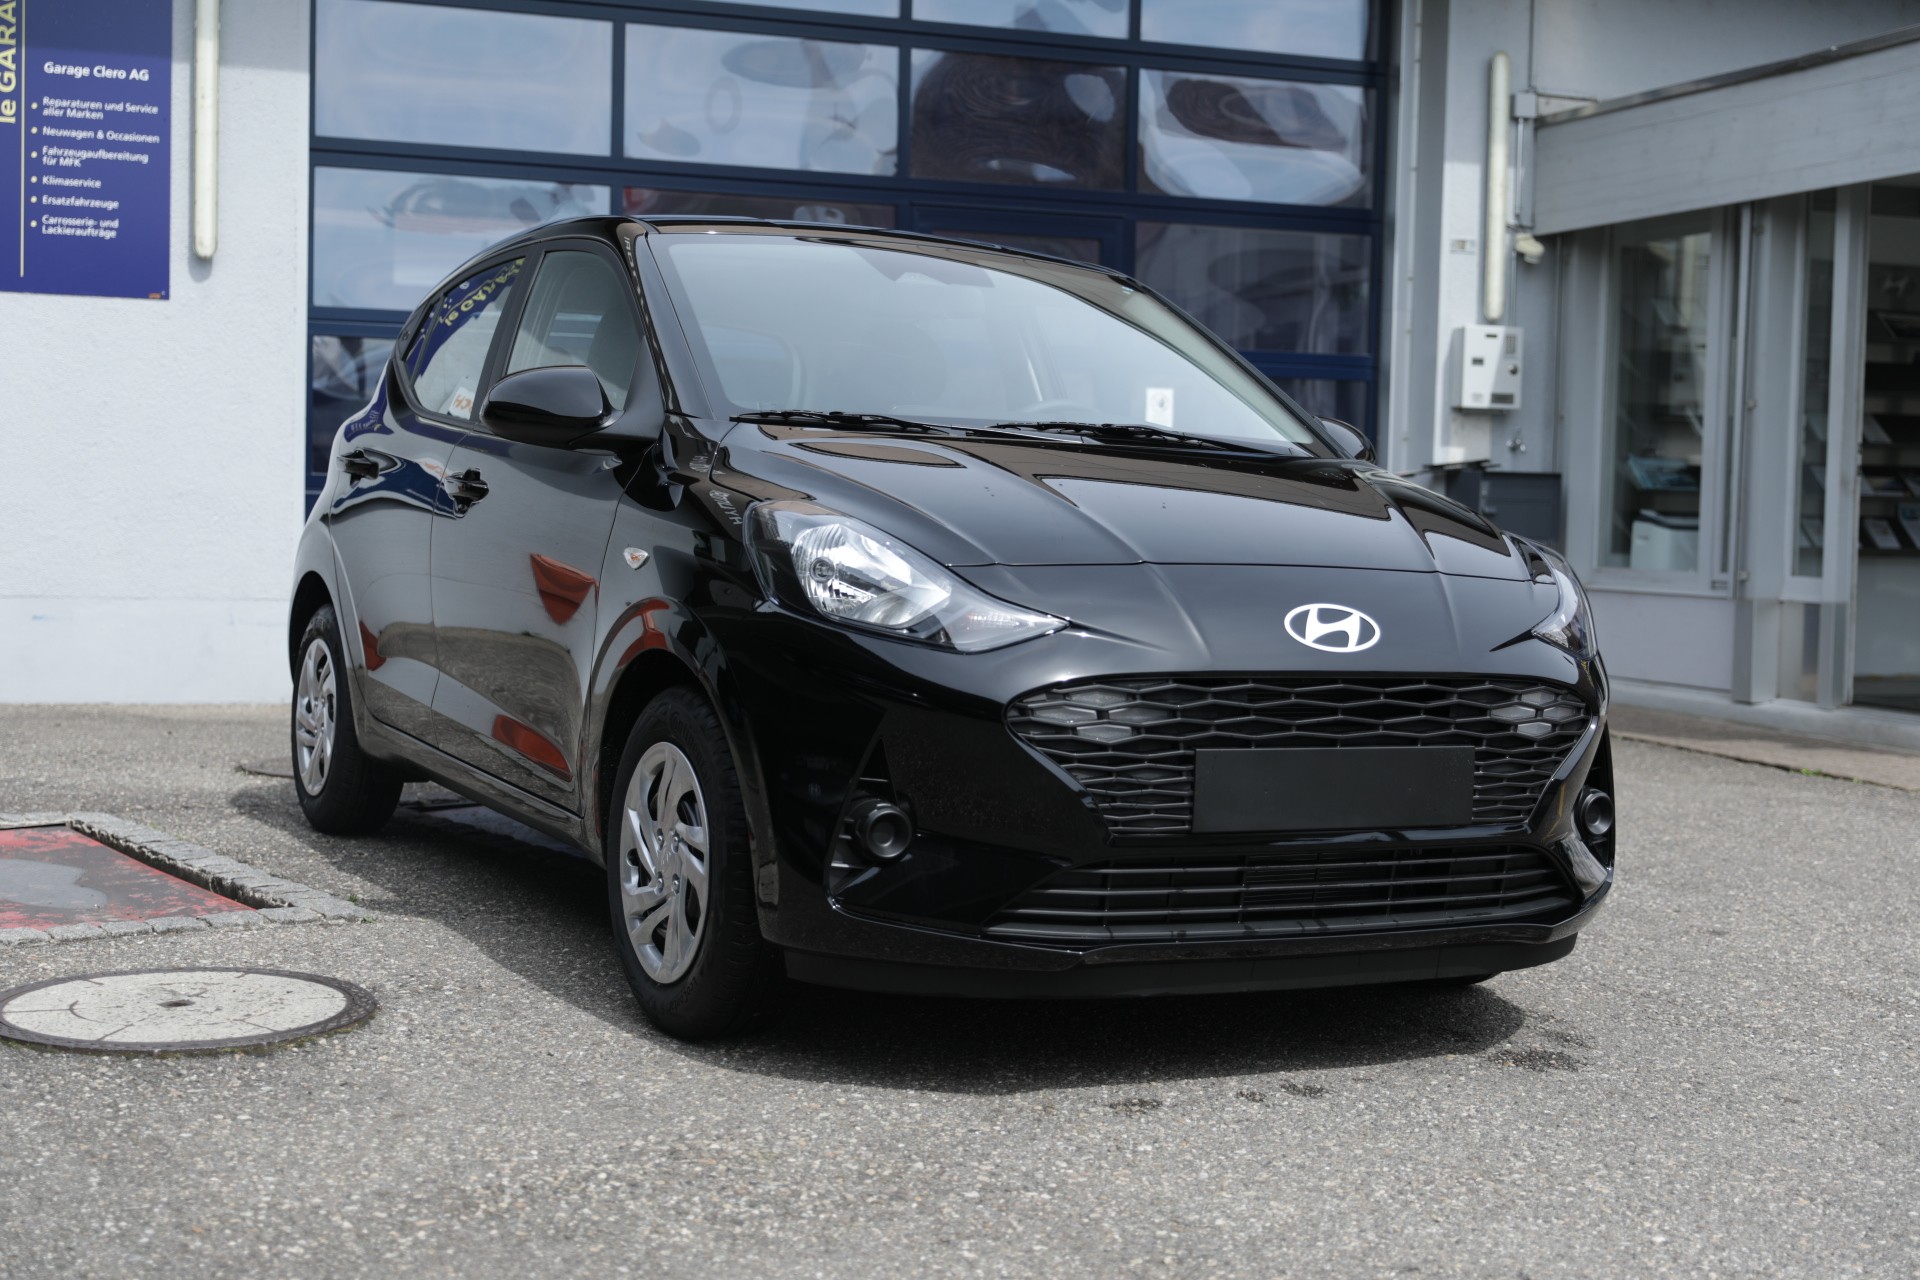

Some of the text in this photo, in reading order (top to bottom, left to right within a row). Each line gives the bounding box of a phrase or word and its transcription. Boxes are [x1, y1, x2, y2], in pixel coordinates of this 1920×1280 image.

[0, 0, 16, 124] le GARA
[44, 62, 149, 81] Garage Clero AG
[42, 96, 159, 114] Reparaturen und Service
[42, 107, 104, 120] aller Marken
[42, 126, 160, 144] Neuwagen & Occasionen
[42, 156, 81, 167] für MFK
[43, 146, 149, 164] Fahrzeugaufbereitung
[42, 175, 101, 188] Klimaservice
[43, 195, 119, 210] Ersatzfahrzeuge
[42, 215, 119, 229] Carrosserie- und
[42, 225, 117, 239] Lackieraufträge
